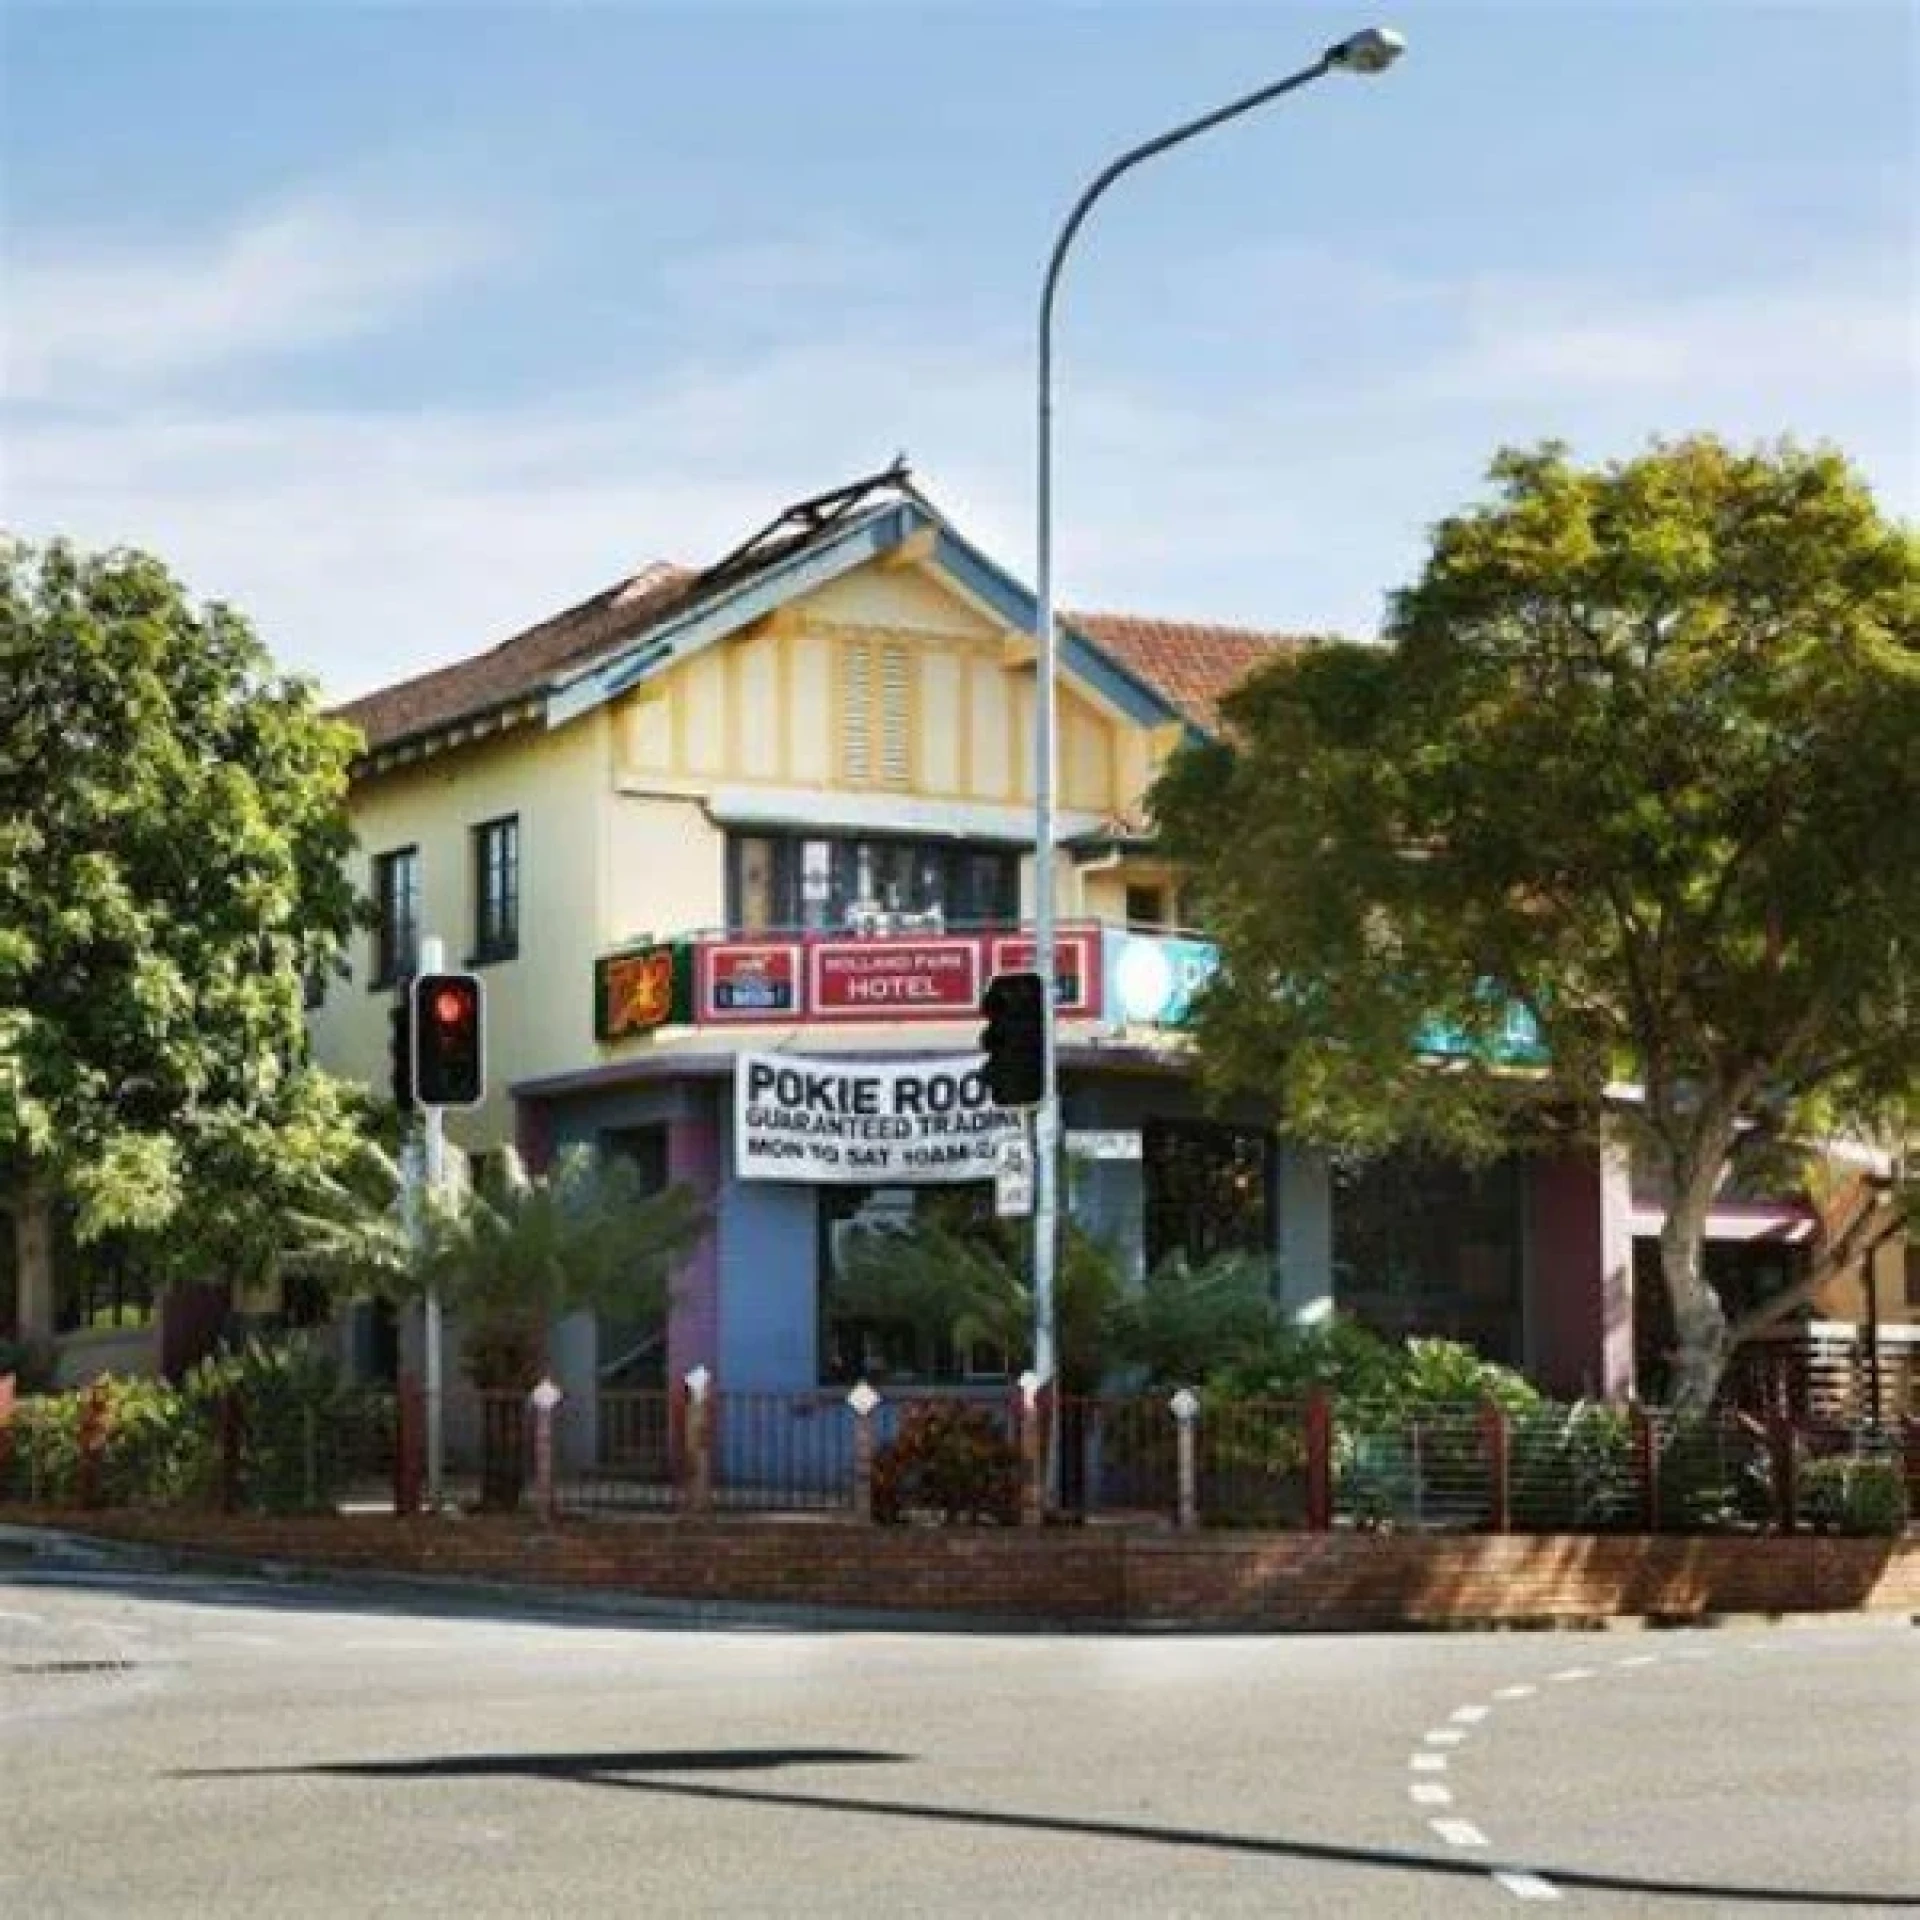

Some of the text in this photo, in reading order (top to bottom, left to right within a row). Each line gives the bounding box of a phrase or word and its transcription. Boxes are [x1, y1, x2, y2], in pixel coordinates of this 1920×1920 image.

[848, 976, 940, 998] HOTEL
[748, 1062, 990, 1115] POKIE ROO
[746, 1107, 912, 1139] GUARANTEED
[748, 1137, 804, 1159] MON
[809, 1141, 839, 1164] TO
[846, 1147, 890, 1168] SAT
